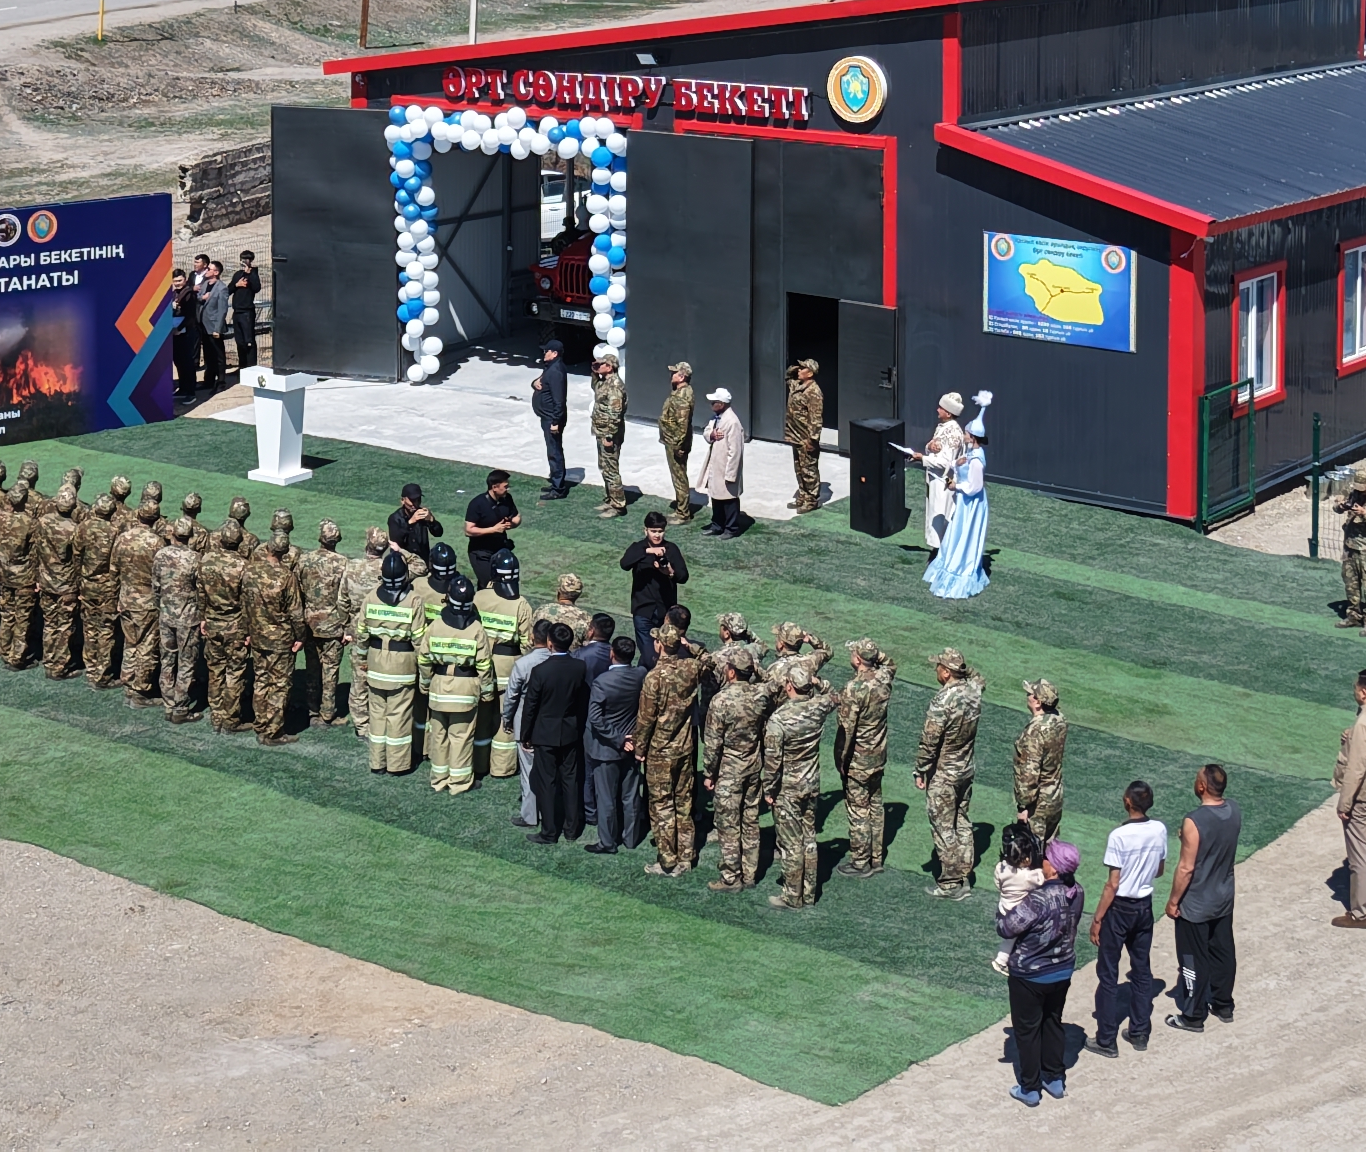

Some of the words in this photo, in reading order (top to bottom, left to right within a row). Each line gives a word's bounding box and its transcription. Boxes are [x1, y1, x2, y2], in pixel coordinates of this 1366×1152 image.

[442, 66, 507, 100] ӨРТ
[512, 69, 666, 112] СӨНДІРУ
[672, 79, 809, 120] БЕКЕТІ
[39, 244, 125, 265] БЕКЕТІНІҢ
